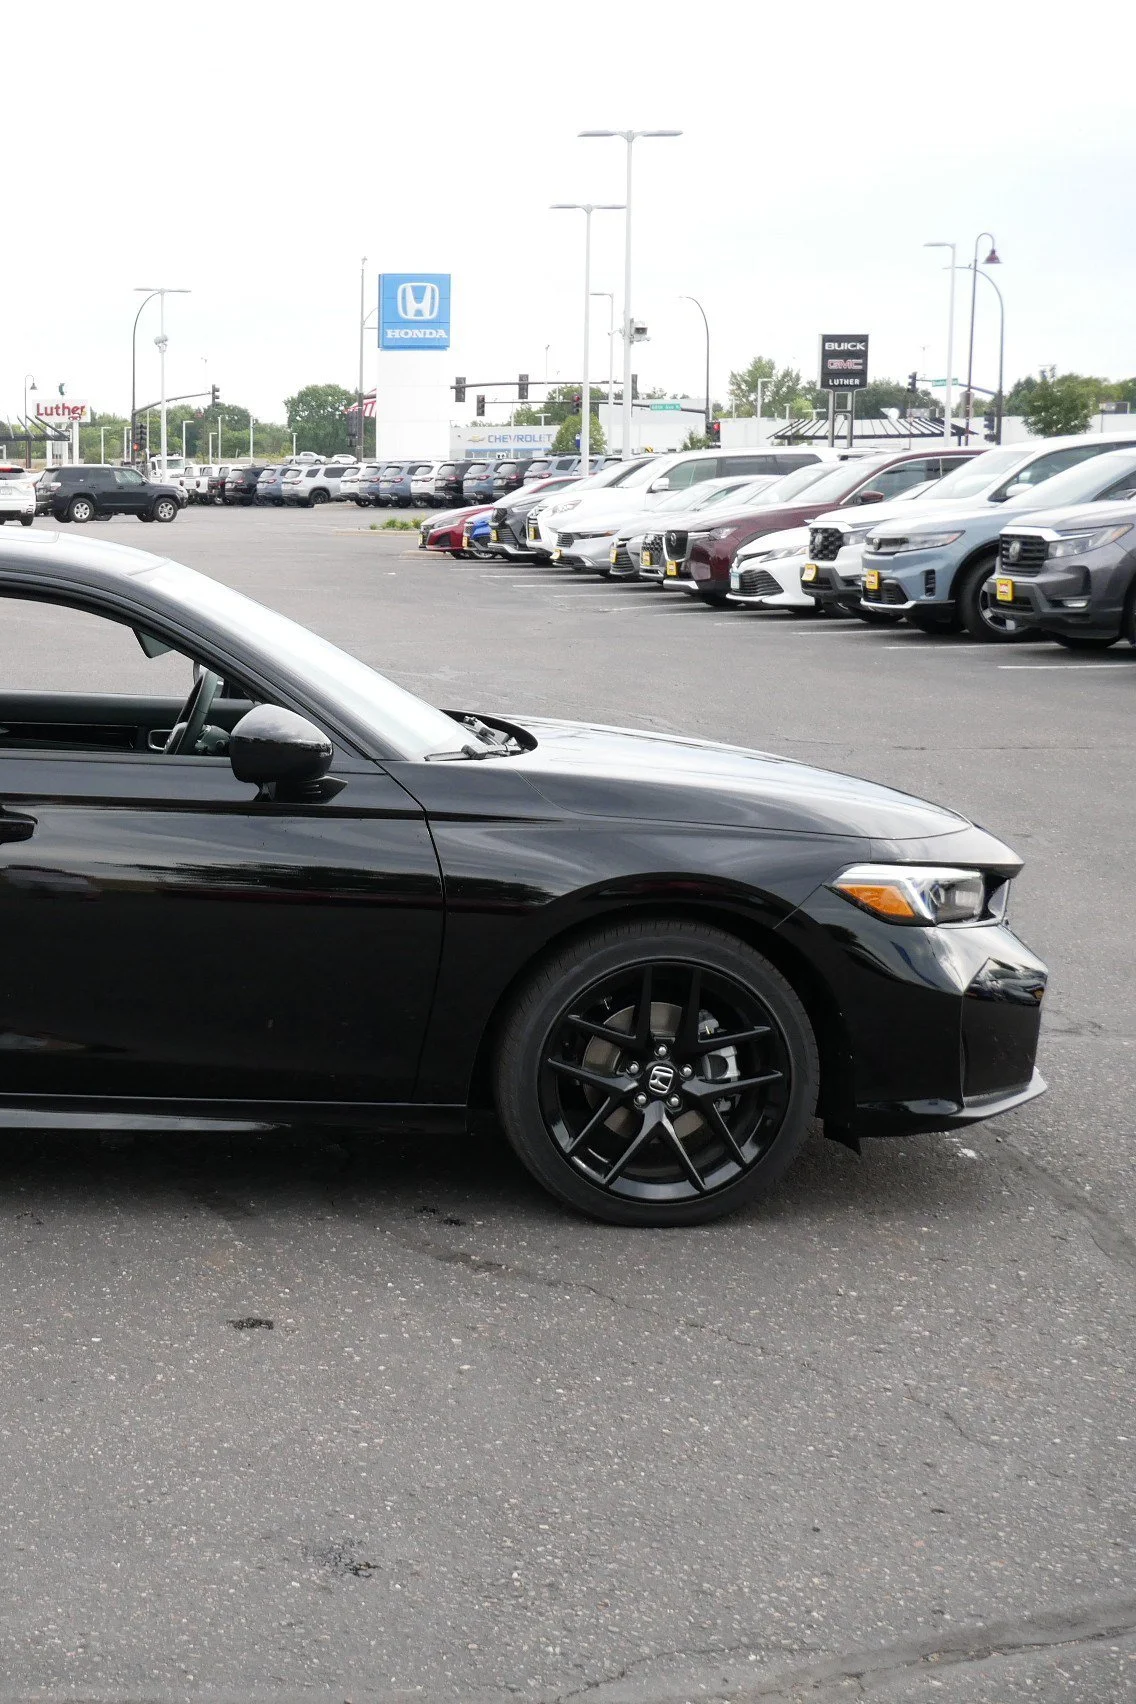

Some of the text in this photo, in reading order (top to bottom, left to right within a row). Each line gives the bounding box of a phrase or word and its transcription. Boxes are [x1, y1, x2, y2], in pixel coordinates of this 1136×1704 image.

[385, 329, 449, 339] HONDA
[824, 342, 866, 350] BUICK
[827, 359, 863, 369] GMC
[828, 378, 860, 386] LUTHER
[36, 403, 86, 416] Luther
[487, 433, 553, 443] CHEVROLET
